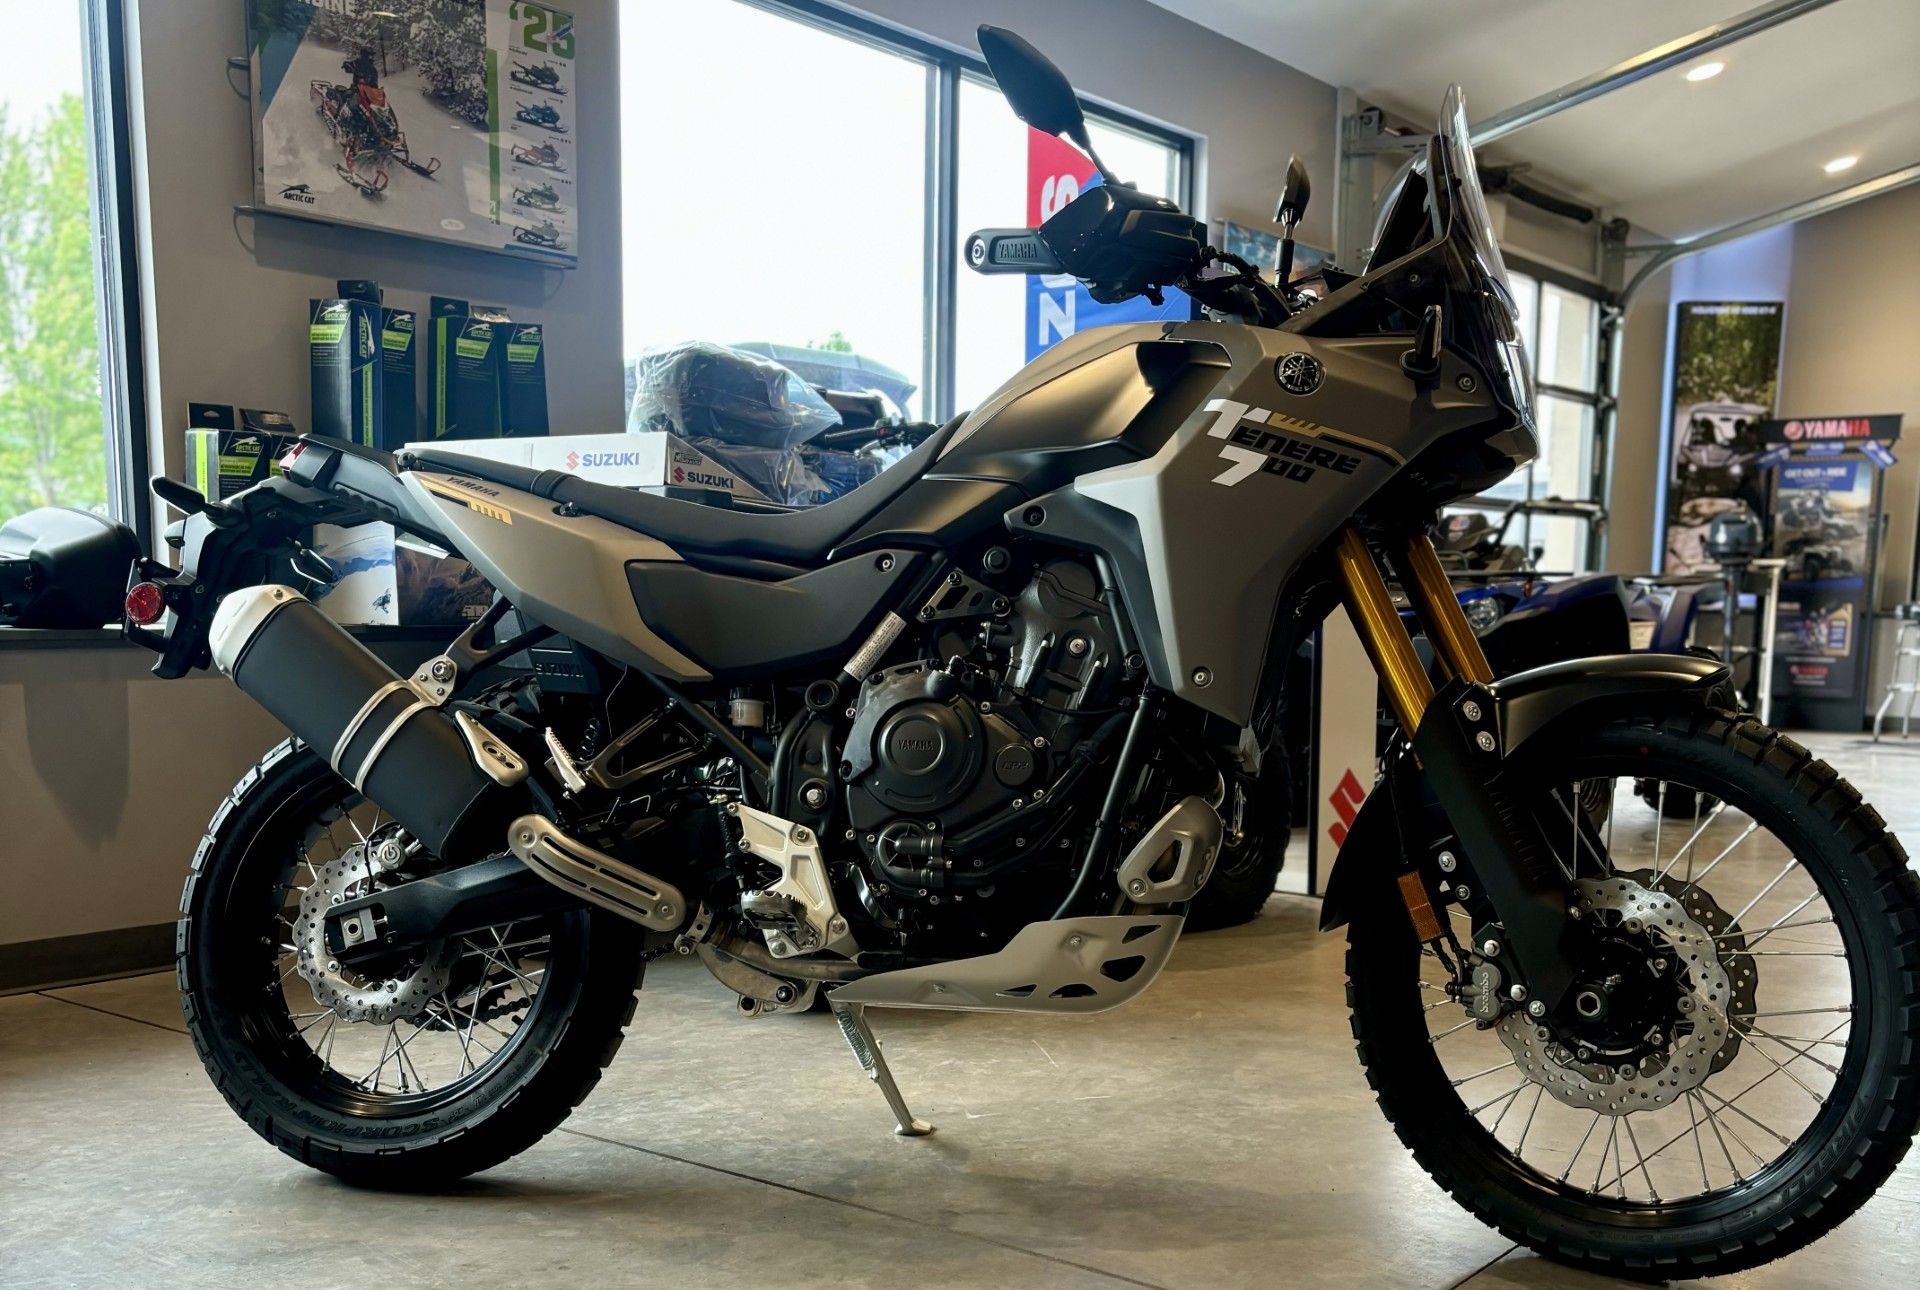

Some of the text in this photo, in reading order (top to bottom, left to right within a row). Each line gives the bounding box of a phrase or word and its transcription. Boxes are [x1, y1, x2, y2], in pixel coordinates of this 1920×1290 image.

[999, 243, 1038, 259] YAMAHA
[1804, 418, 1872, 438] YAMAHA
[583, 452, 640, 467] SUZUKI
[1211, 445, 1316, 487] 700
[447, 476, 500, 497] YAMAHA
[687, 471, 734, 489] SUZUKI
[899, 739, 934, 751] YAMAHA
[1480, 972, 1489, 1013] brembo
